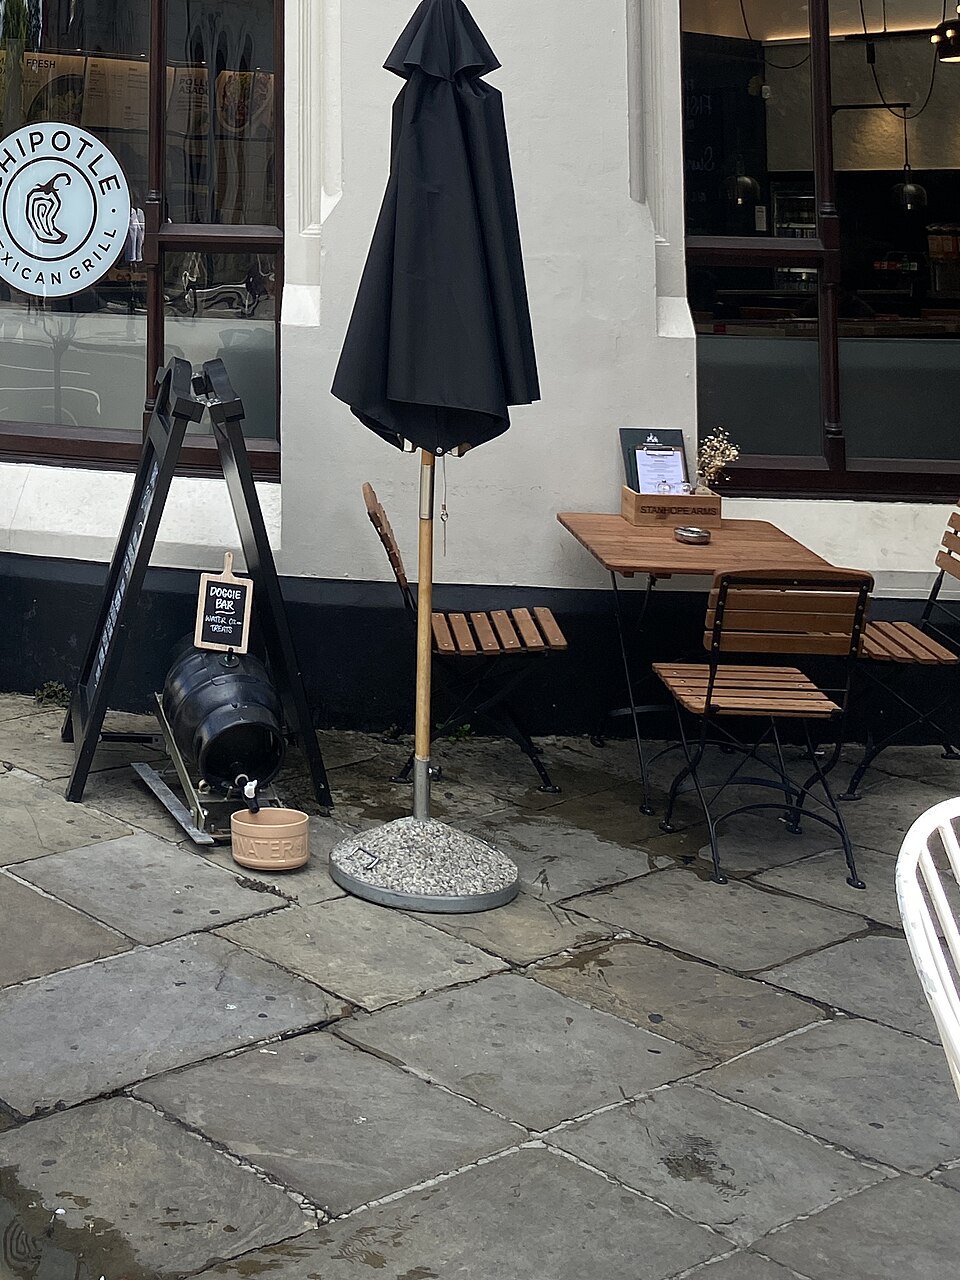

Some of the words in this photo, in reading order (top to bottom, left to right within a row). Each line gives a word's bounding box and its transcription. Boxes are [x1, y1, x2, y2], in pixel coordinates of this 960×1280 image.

[69, 229, 117, 280] GRILL
[691, 507, 718, 516] ARMS
[209, 586, 241, 600] DOGGIE
[215, 599, 234, 611] BAR
[205, 615, 227, 625] WATER
[234, 837, 294, 860] WATER
